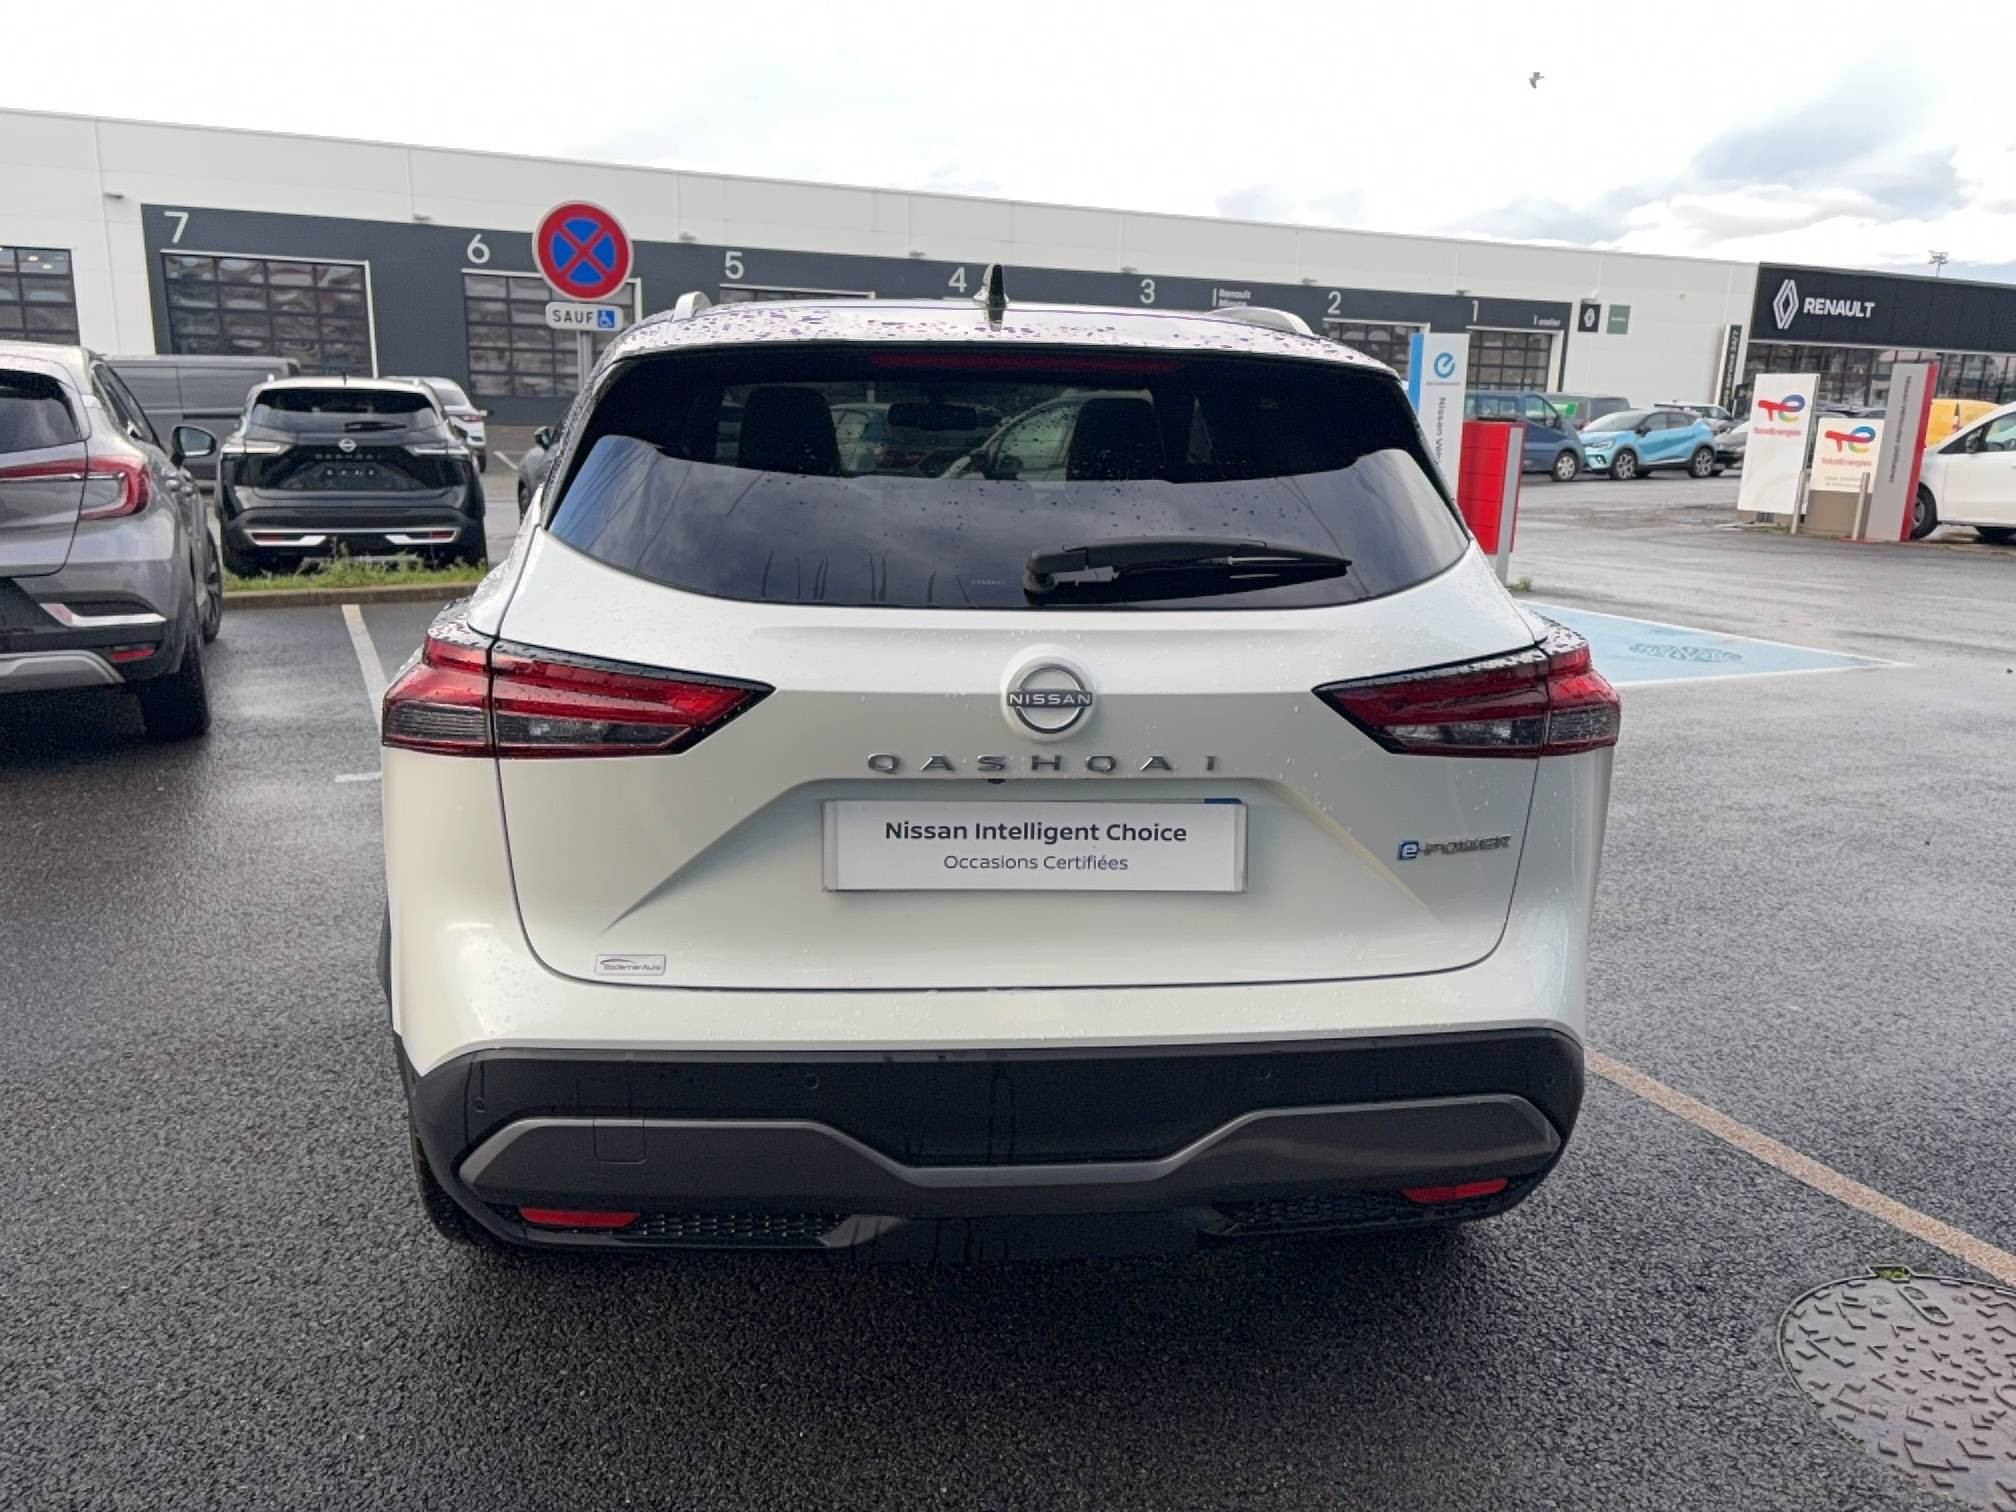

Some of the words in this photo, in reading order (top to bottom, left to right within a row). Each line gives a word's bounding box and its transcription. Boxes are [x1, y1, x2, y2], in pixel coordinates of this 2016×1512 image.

[164, 210, 189, 243] 7
[467, 233, 490, 264] 6
[724, 251, 745, 279] 5
[948, 267, 967, 292] 4
[1140, 279, 1156, 304] 3
[1327, 291, 1341, 315] 2
[1472, 300, 1479, 322] 1
[1803, 297, 1876, 318] RENAULT
[552, 309, 594, 324] SAUF
[1009, 692, 1093, 706] NISSAN
[867, 753, 1218, 775] QASHQAI
[884, 821, 968, 841] Nissan
[974, 821, 1101, 845] Intelligent
[1105, 822, 1188, 842] Choice
[943, 854, 1039, 871] Occasions
[1043, 854, 1129, 872] Certifiées
